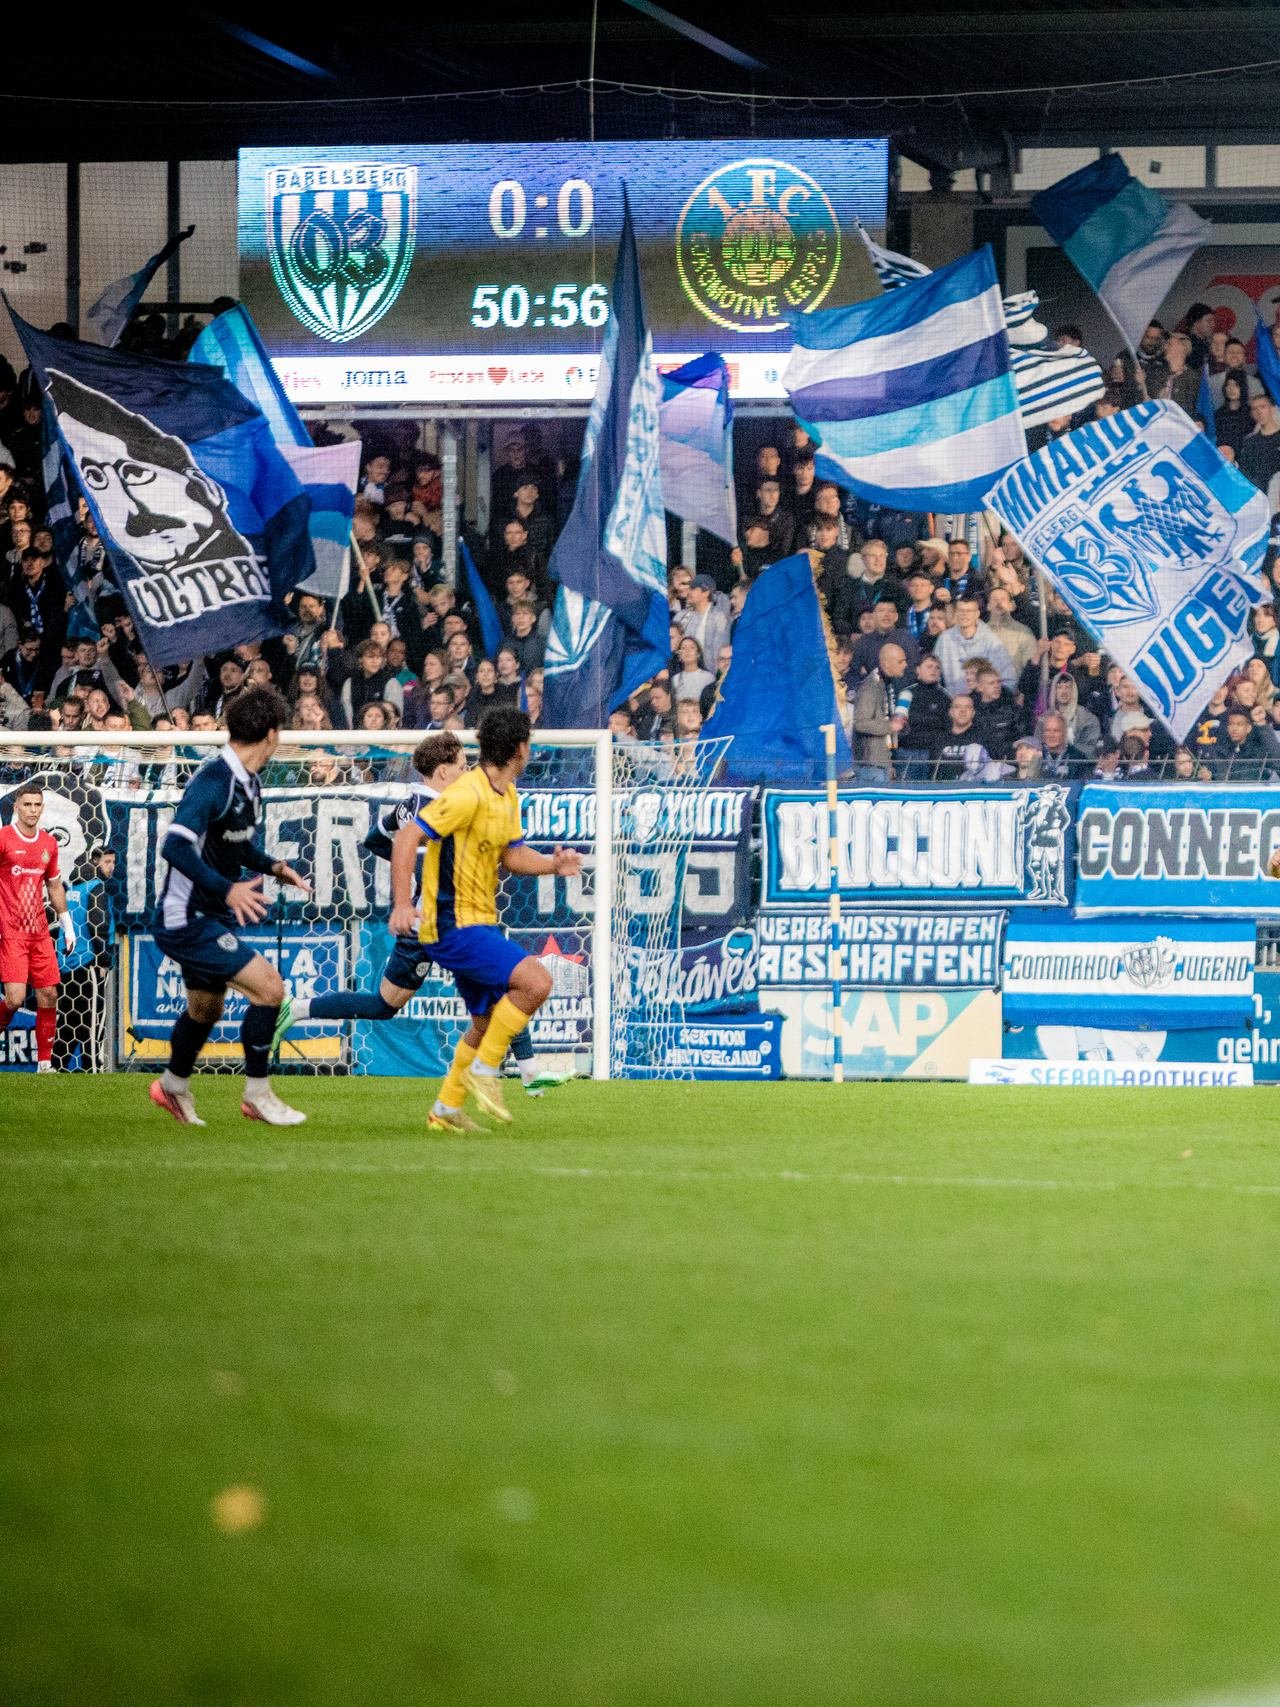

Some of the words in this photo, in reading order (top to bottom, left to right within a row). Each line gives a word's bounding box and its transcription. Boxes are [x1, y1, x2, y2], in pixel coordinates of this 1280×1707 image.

[489, 178, 594, 240] 0:0
[470, 283, 610, 330] 50:56
[1008, 953, 1123, 981] COMMANDO
[804, 991, 949, 1055] SAP
